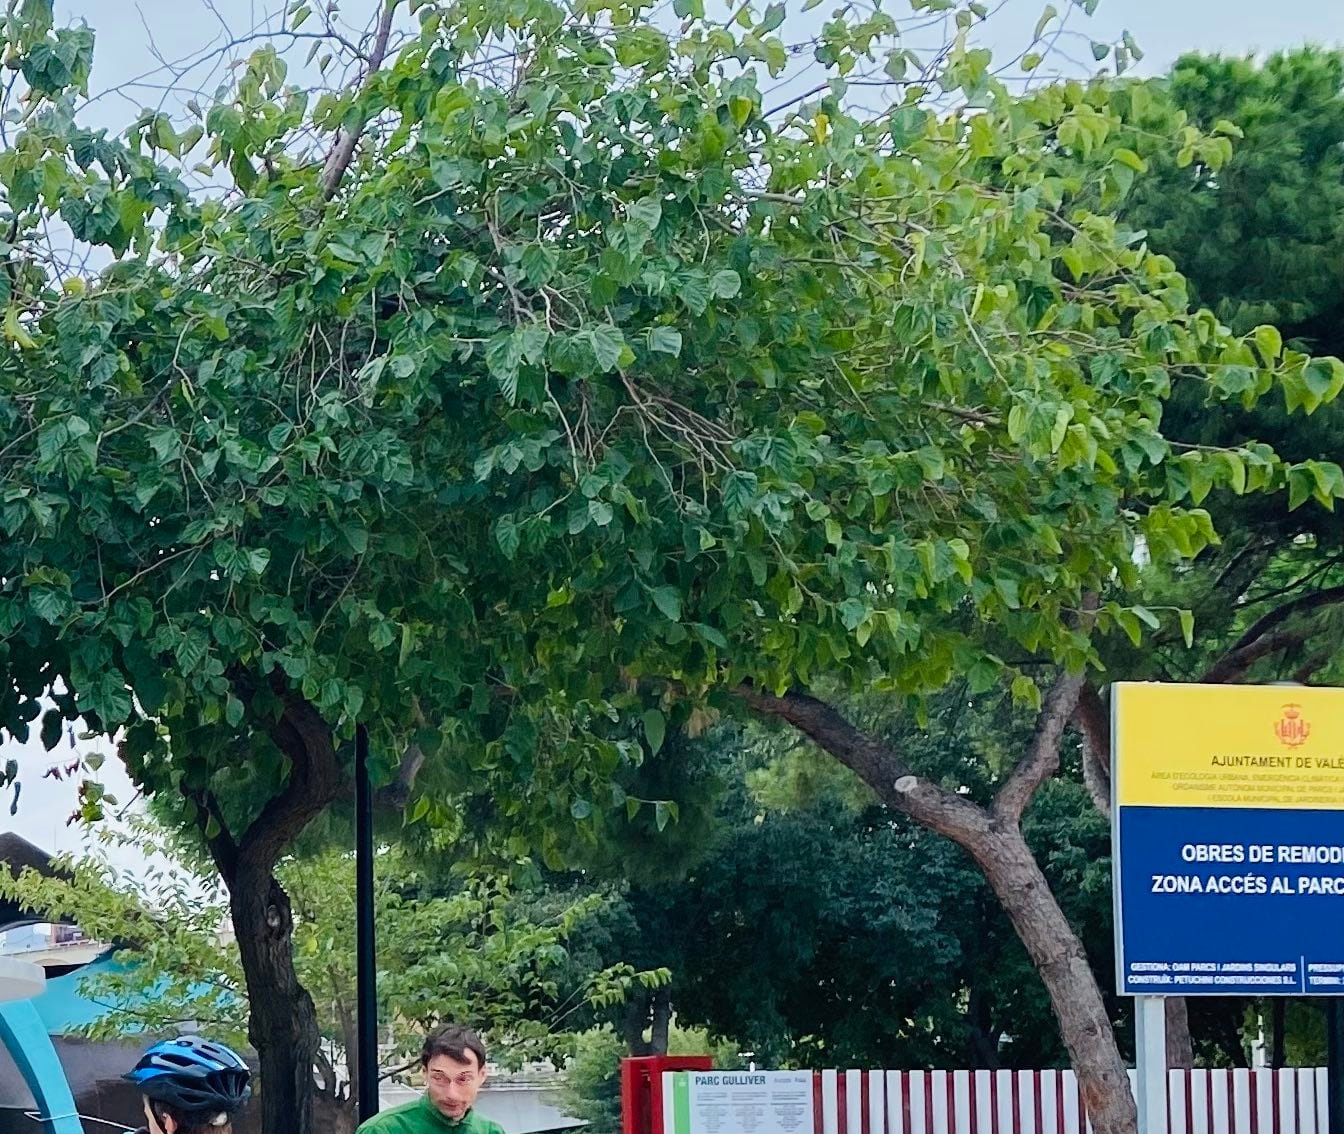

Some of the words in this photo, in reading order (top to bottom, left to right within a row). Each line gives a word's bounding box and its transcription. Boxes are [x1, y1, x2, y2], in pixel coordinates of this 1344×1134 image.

[1212, 756, 1292, 768] AJUNTAMENT
[1295, 757, 1312, 768] DE
[1181, 844, 1245, 862] OBRES
[1248, 845, 1274, 863] DE
[1151, 875, 1203, 893] ZONA
[1205, 872, 1267, 894] ACCÉS
[1270, 877, 1296, 894] AL
[1298, 877, 1344, 894] PARC
[695, 1076, 720, 1086] PARC
[722, 1075, 766, 1086] GULLIVER
